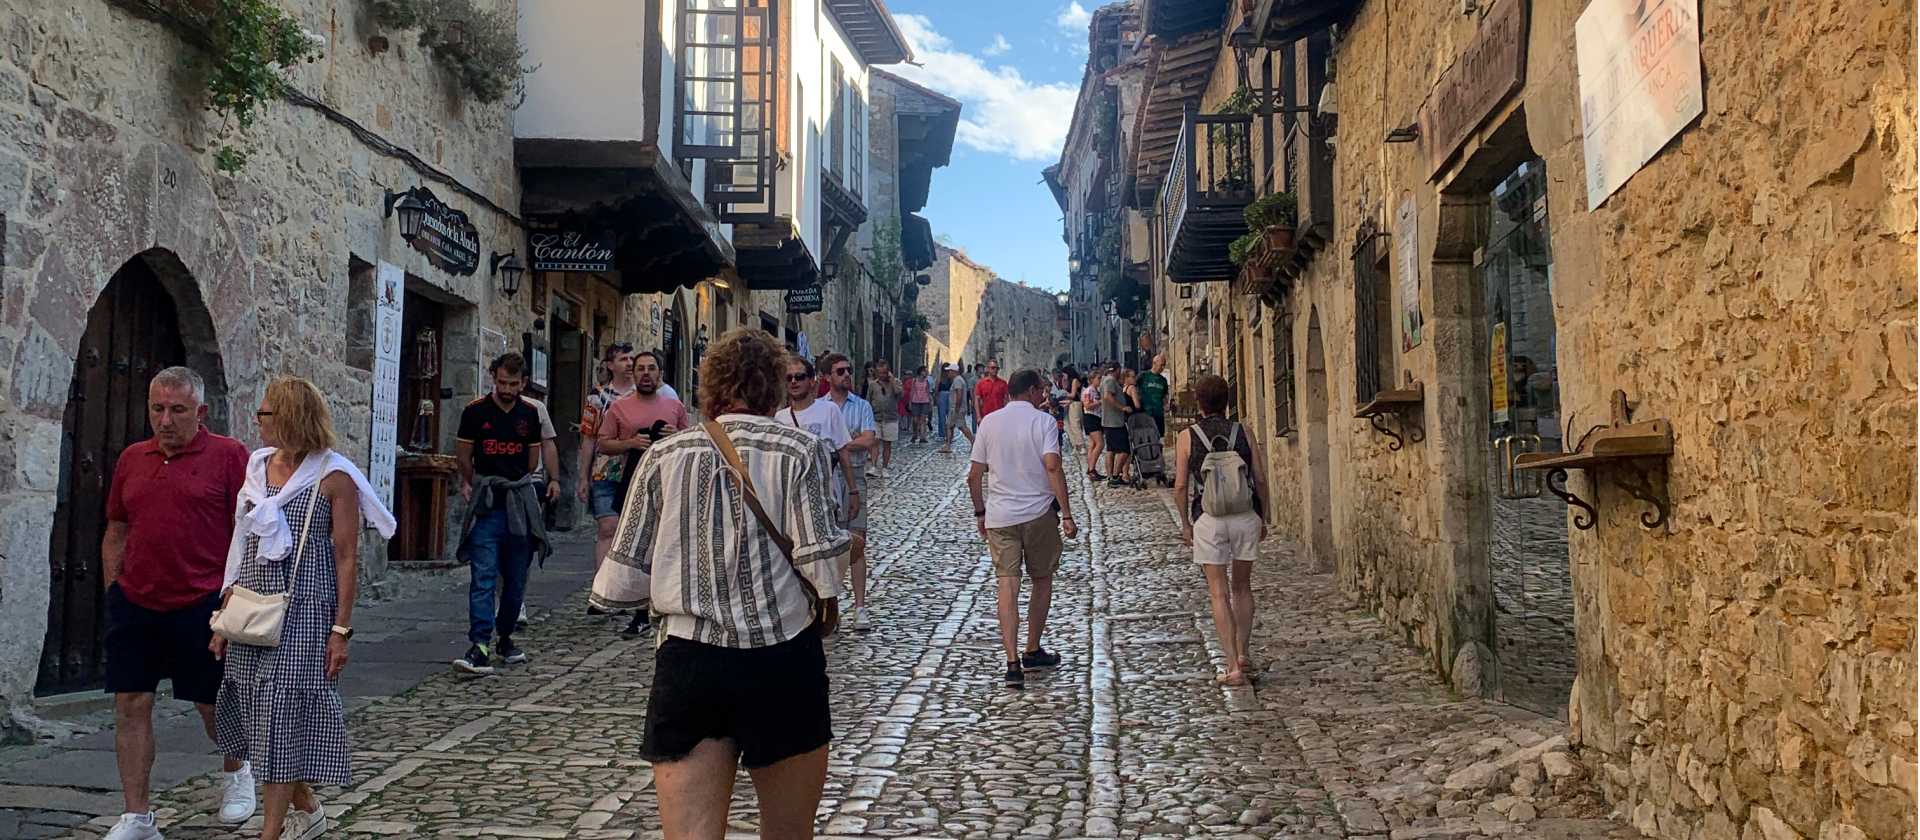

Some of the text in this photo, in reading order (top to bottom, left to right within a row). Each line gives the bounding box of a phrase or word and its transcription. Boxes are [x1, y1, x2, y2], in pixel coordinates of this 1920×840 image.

[163, 167, 177, 189] 20
[531, 233, 614, 261] Cantón
[563, 231, 582, 248] El
